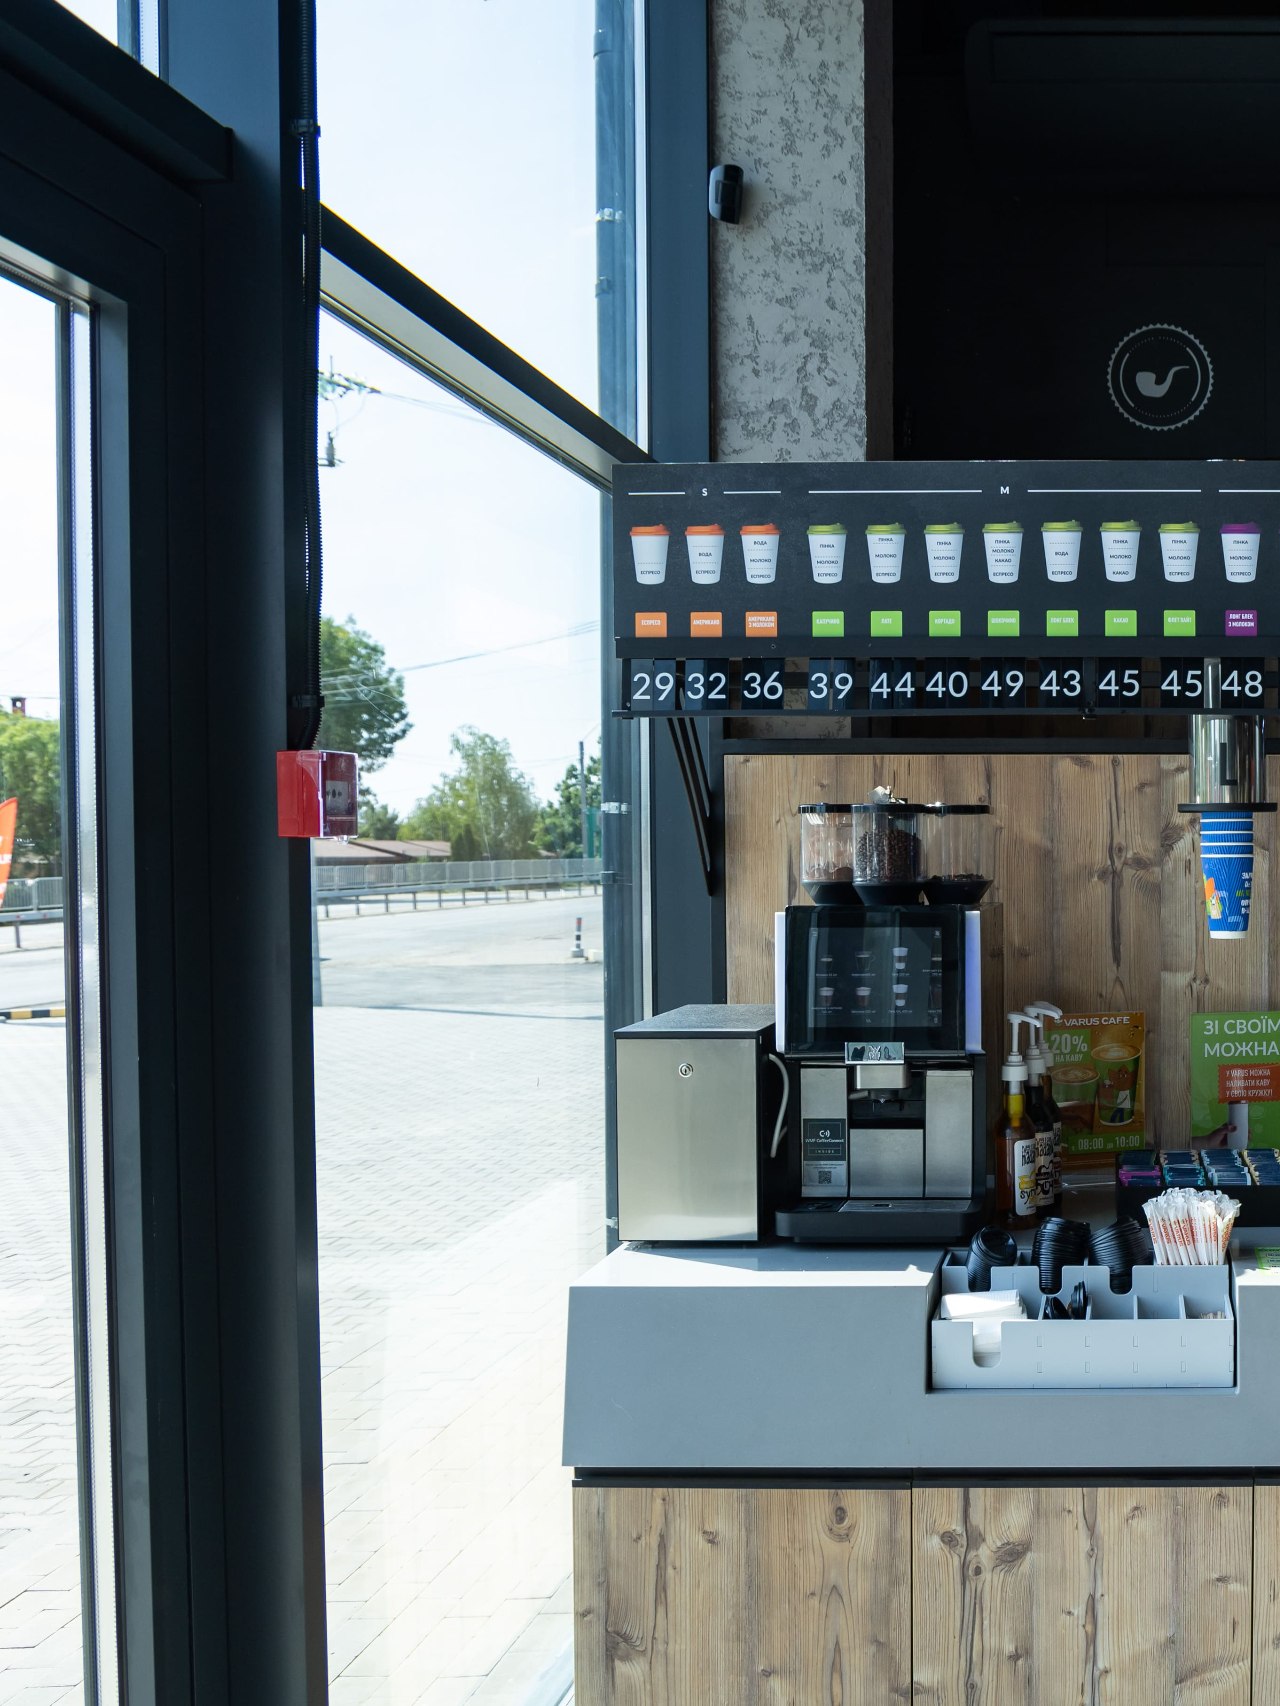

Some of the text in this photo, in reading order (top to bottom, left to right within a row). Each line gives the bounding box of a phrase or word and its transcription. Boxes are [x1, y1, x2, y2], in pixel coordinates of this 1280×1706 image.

[702, 488, 708, 496] S
[1001, 486, 1010, 494] M
[632, 671, 674, 700] 29
[686, 671, 726, 700] 32
[743, 671, 783, 700] 36
[809, 671, 854, 700] 39
[870, 671, 916, 698] 44
[926, 671, 969, 698] 40
[981, 670, 1024, 698] 49
[1040, 670, 1081, 697] 43
[1099, 670, 1140, 698] 45
[1161, 670, 1202, 698] 45
[1221, 670, 1263, 698] 48
[1220, 742, 1238, 786] L
[1064, 1017, 1100, 1026] VARUS
[1204, 1020, 1218, 1035] ЗІ
[1051, 1034, 1088, 1053] 20%
[1230, 1069, 1248, 1077] VARUS
[1078, 1135, 1140, 1150] 08:00 10:00
